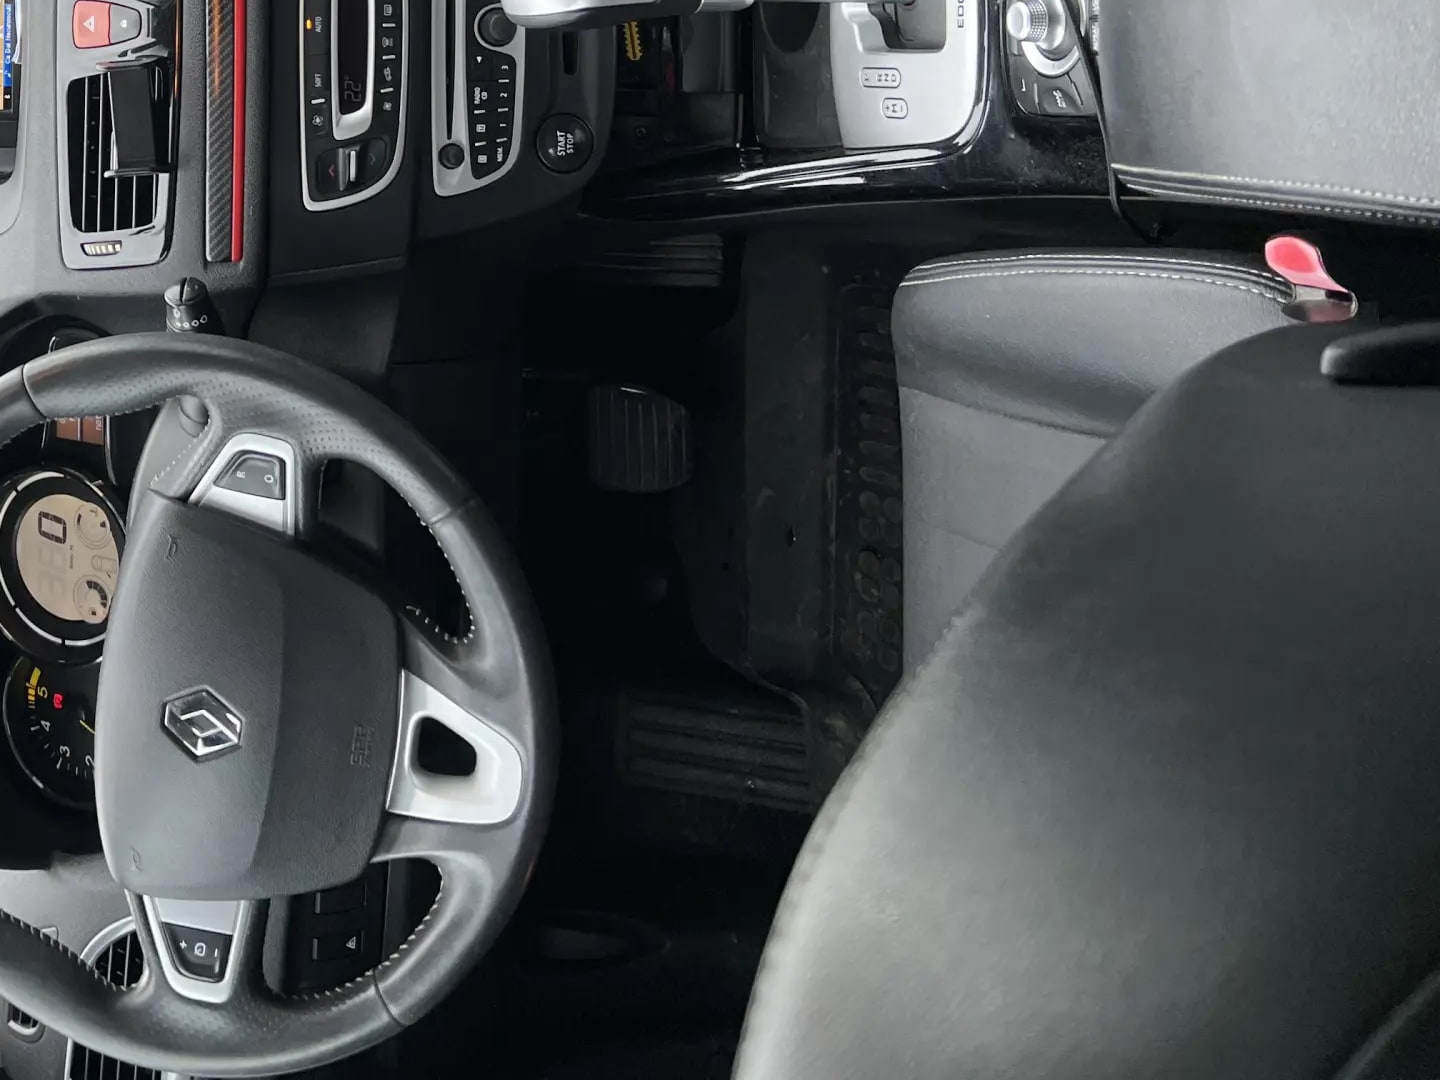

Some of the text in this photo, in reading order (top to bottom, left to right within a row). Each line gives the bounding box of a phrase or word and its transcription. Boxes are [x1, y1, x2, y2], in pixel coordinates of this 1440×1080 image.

[314, 73, 322, 87] SOFT
[481, 91, 487, 100] CD
[557, 130, 566, 156] START
[566, 133, 574, 154] STOP
[38, 511, 67, 544] 0
[37, 686, 48, 699] 5
[40, 720, 51, 732] 4
[60, 745, 70, 757] 3
